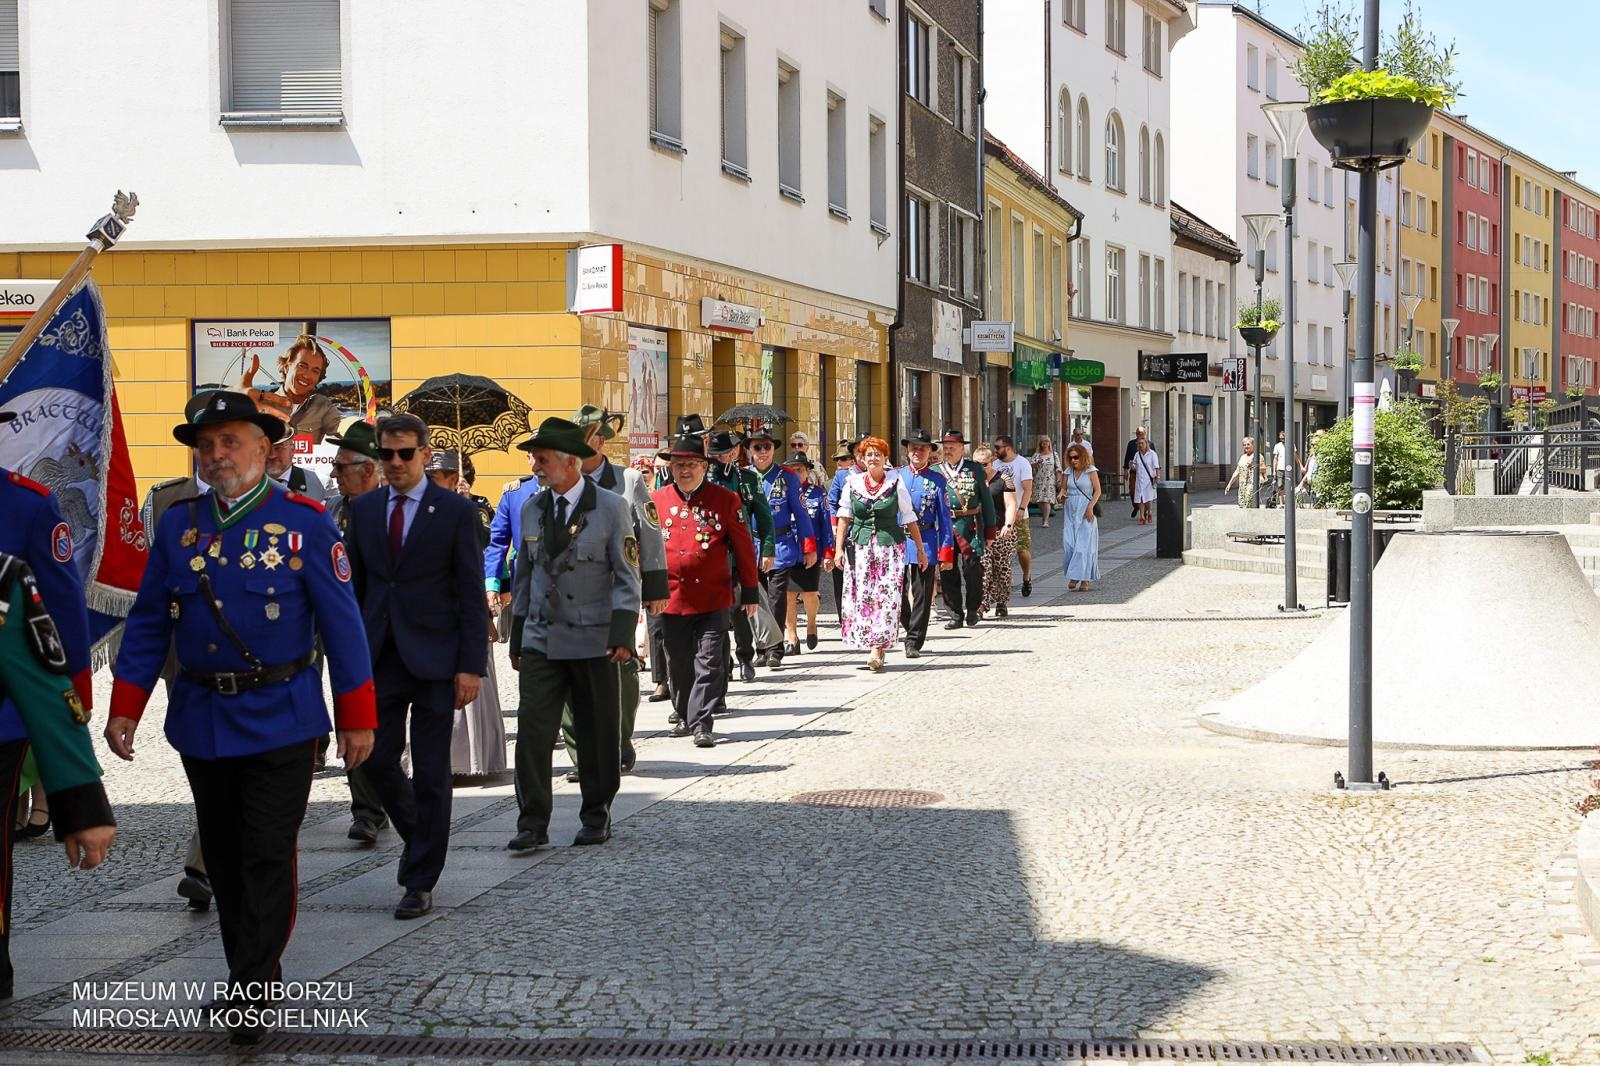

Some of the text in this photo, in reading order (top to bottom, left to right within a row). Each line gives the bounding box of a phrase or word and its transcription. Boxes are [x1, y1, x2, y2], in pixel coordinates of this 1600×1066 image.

[227, 328, 275, 337] Bank Pekao
[1065, 365, 1101, 376] żabka
